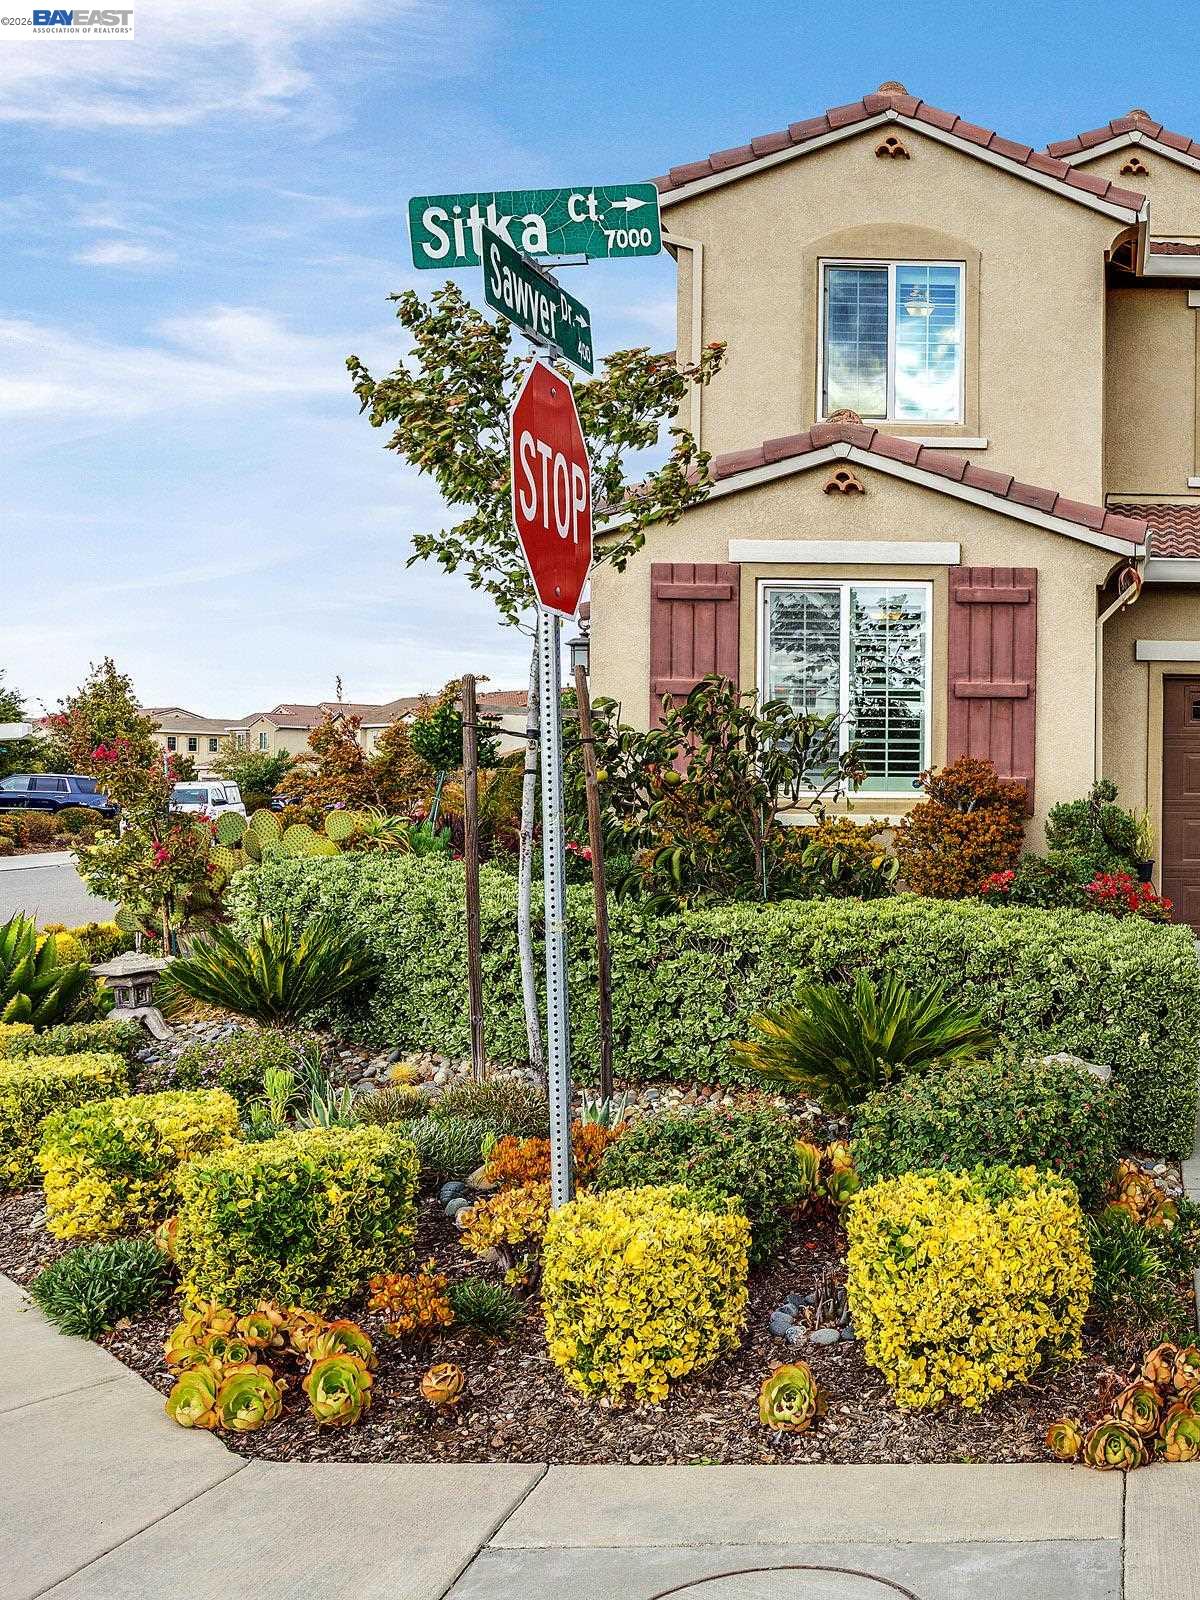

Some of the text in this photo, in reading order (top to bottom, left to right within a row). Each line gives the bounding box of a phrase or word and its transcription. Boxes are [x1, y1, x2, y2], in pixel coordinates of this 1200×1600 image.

[422, 193, 605, 259] Sitka Ct.
[604, 228, 652, 249] 7000
[489, 242, 558, 339] Sawyer
[519, 430, 586, 544] STOP
